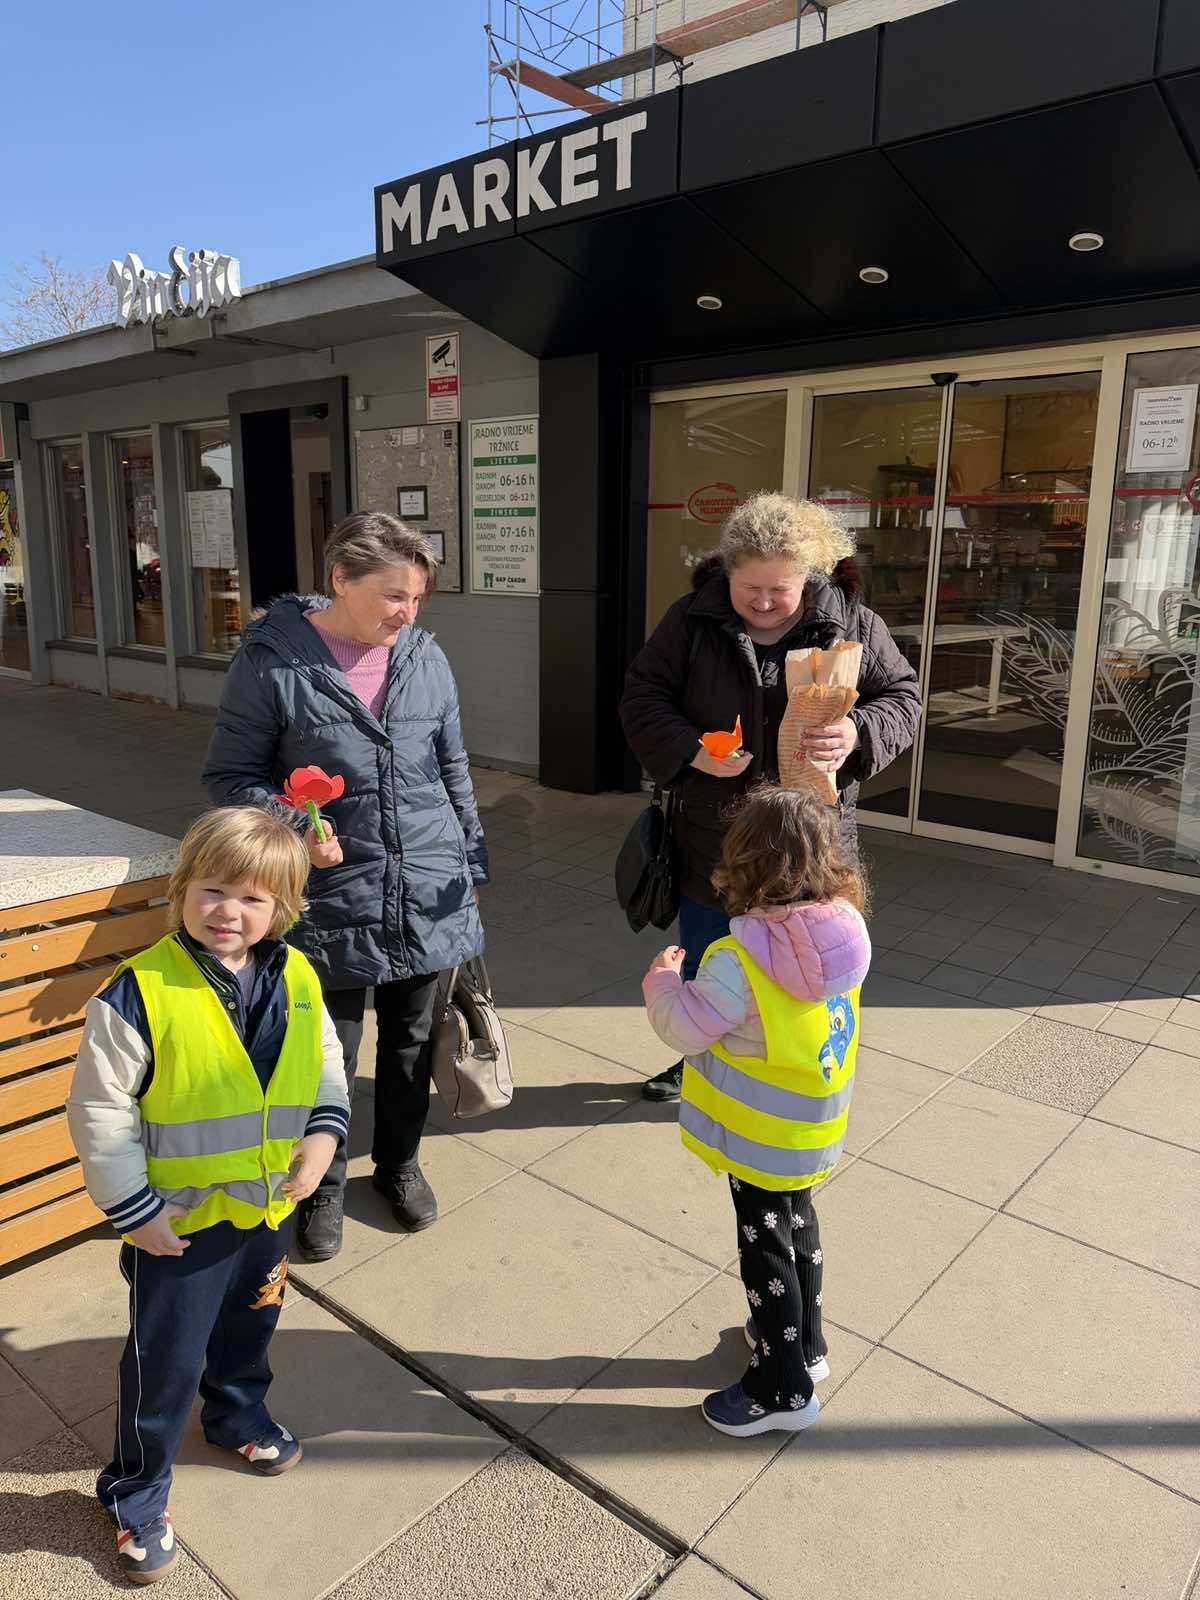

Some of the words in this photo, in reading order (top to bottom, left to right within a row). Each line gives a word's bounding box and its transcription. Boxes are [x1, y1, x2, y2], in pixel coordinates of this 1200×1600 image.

[380, 111, 648, 254] MARKET
[474, 427, 502, 440] RADNO
[502, 424, 534, 437] VRIJEME
[488, 440, 521, 453] TRŽNICE
[499, 474, 527, 487] 06-16
[529, 472, 535, 486] h
[509, 493, 529, 502] 06-12
[530, 492, 535, 502] h
[500, 525, 527, 538] 07-16
[529, 525, 535, 537] h
[509, 544, 529, 553] 07-12
[530, 544, 535, 553] h
